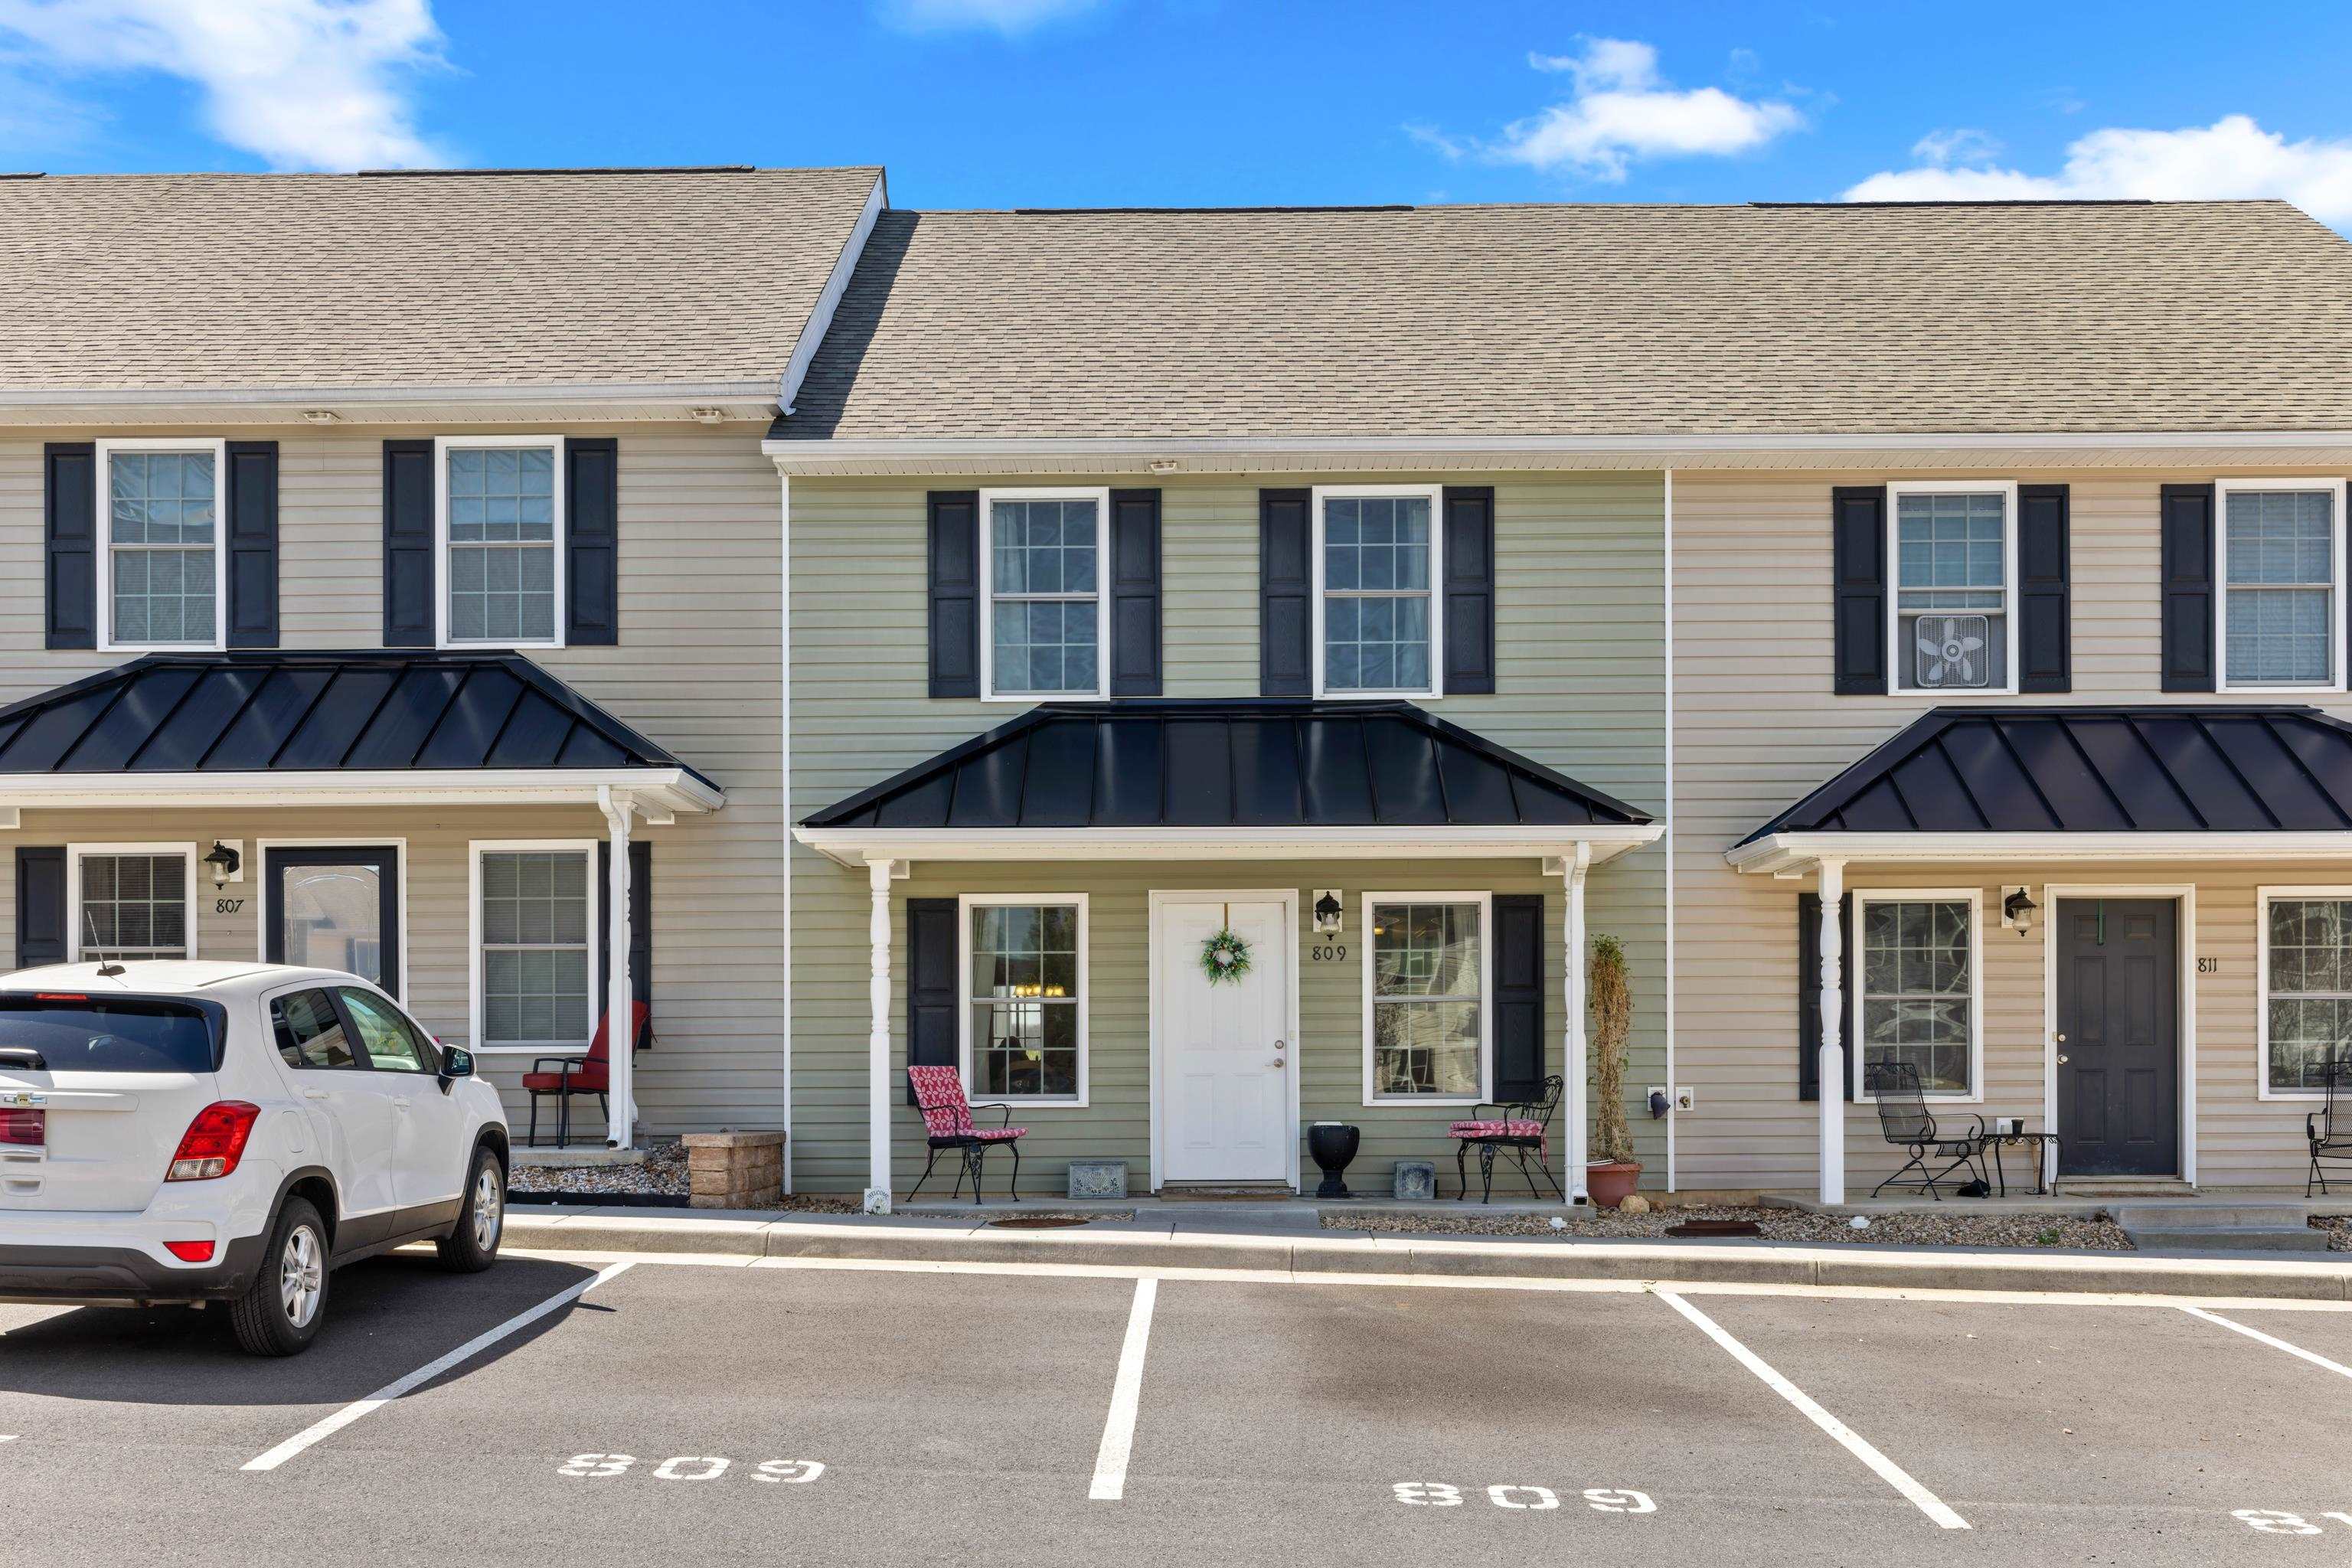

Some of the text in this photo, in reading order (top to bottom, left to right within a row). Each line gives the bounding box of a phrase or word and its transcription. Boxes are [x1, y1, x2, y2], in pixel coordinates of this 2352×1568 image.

[216, 899, 244, 913] 807
[1312, 946, 1346, 961] 809
[2198, 958, 2217, 972] 811
[557, 1454, 826, 1483] 809
[1392, 1482, 1657, 1513] 809
